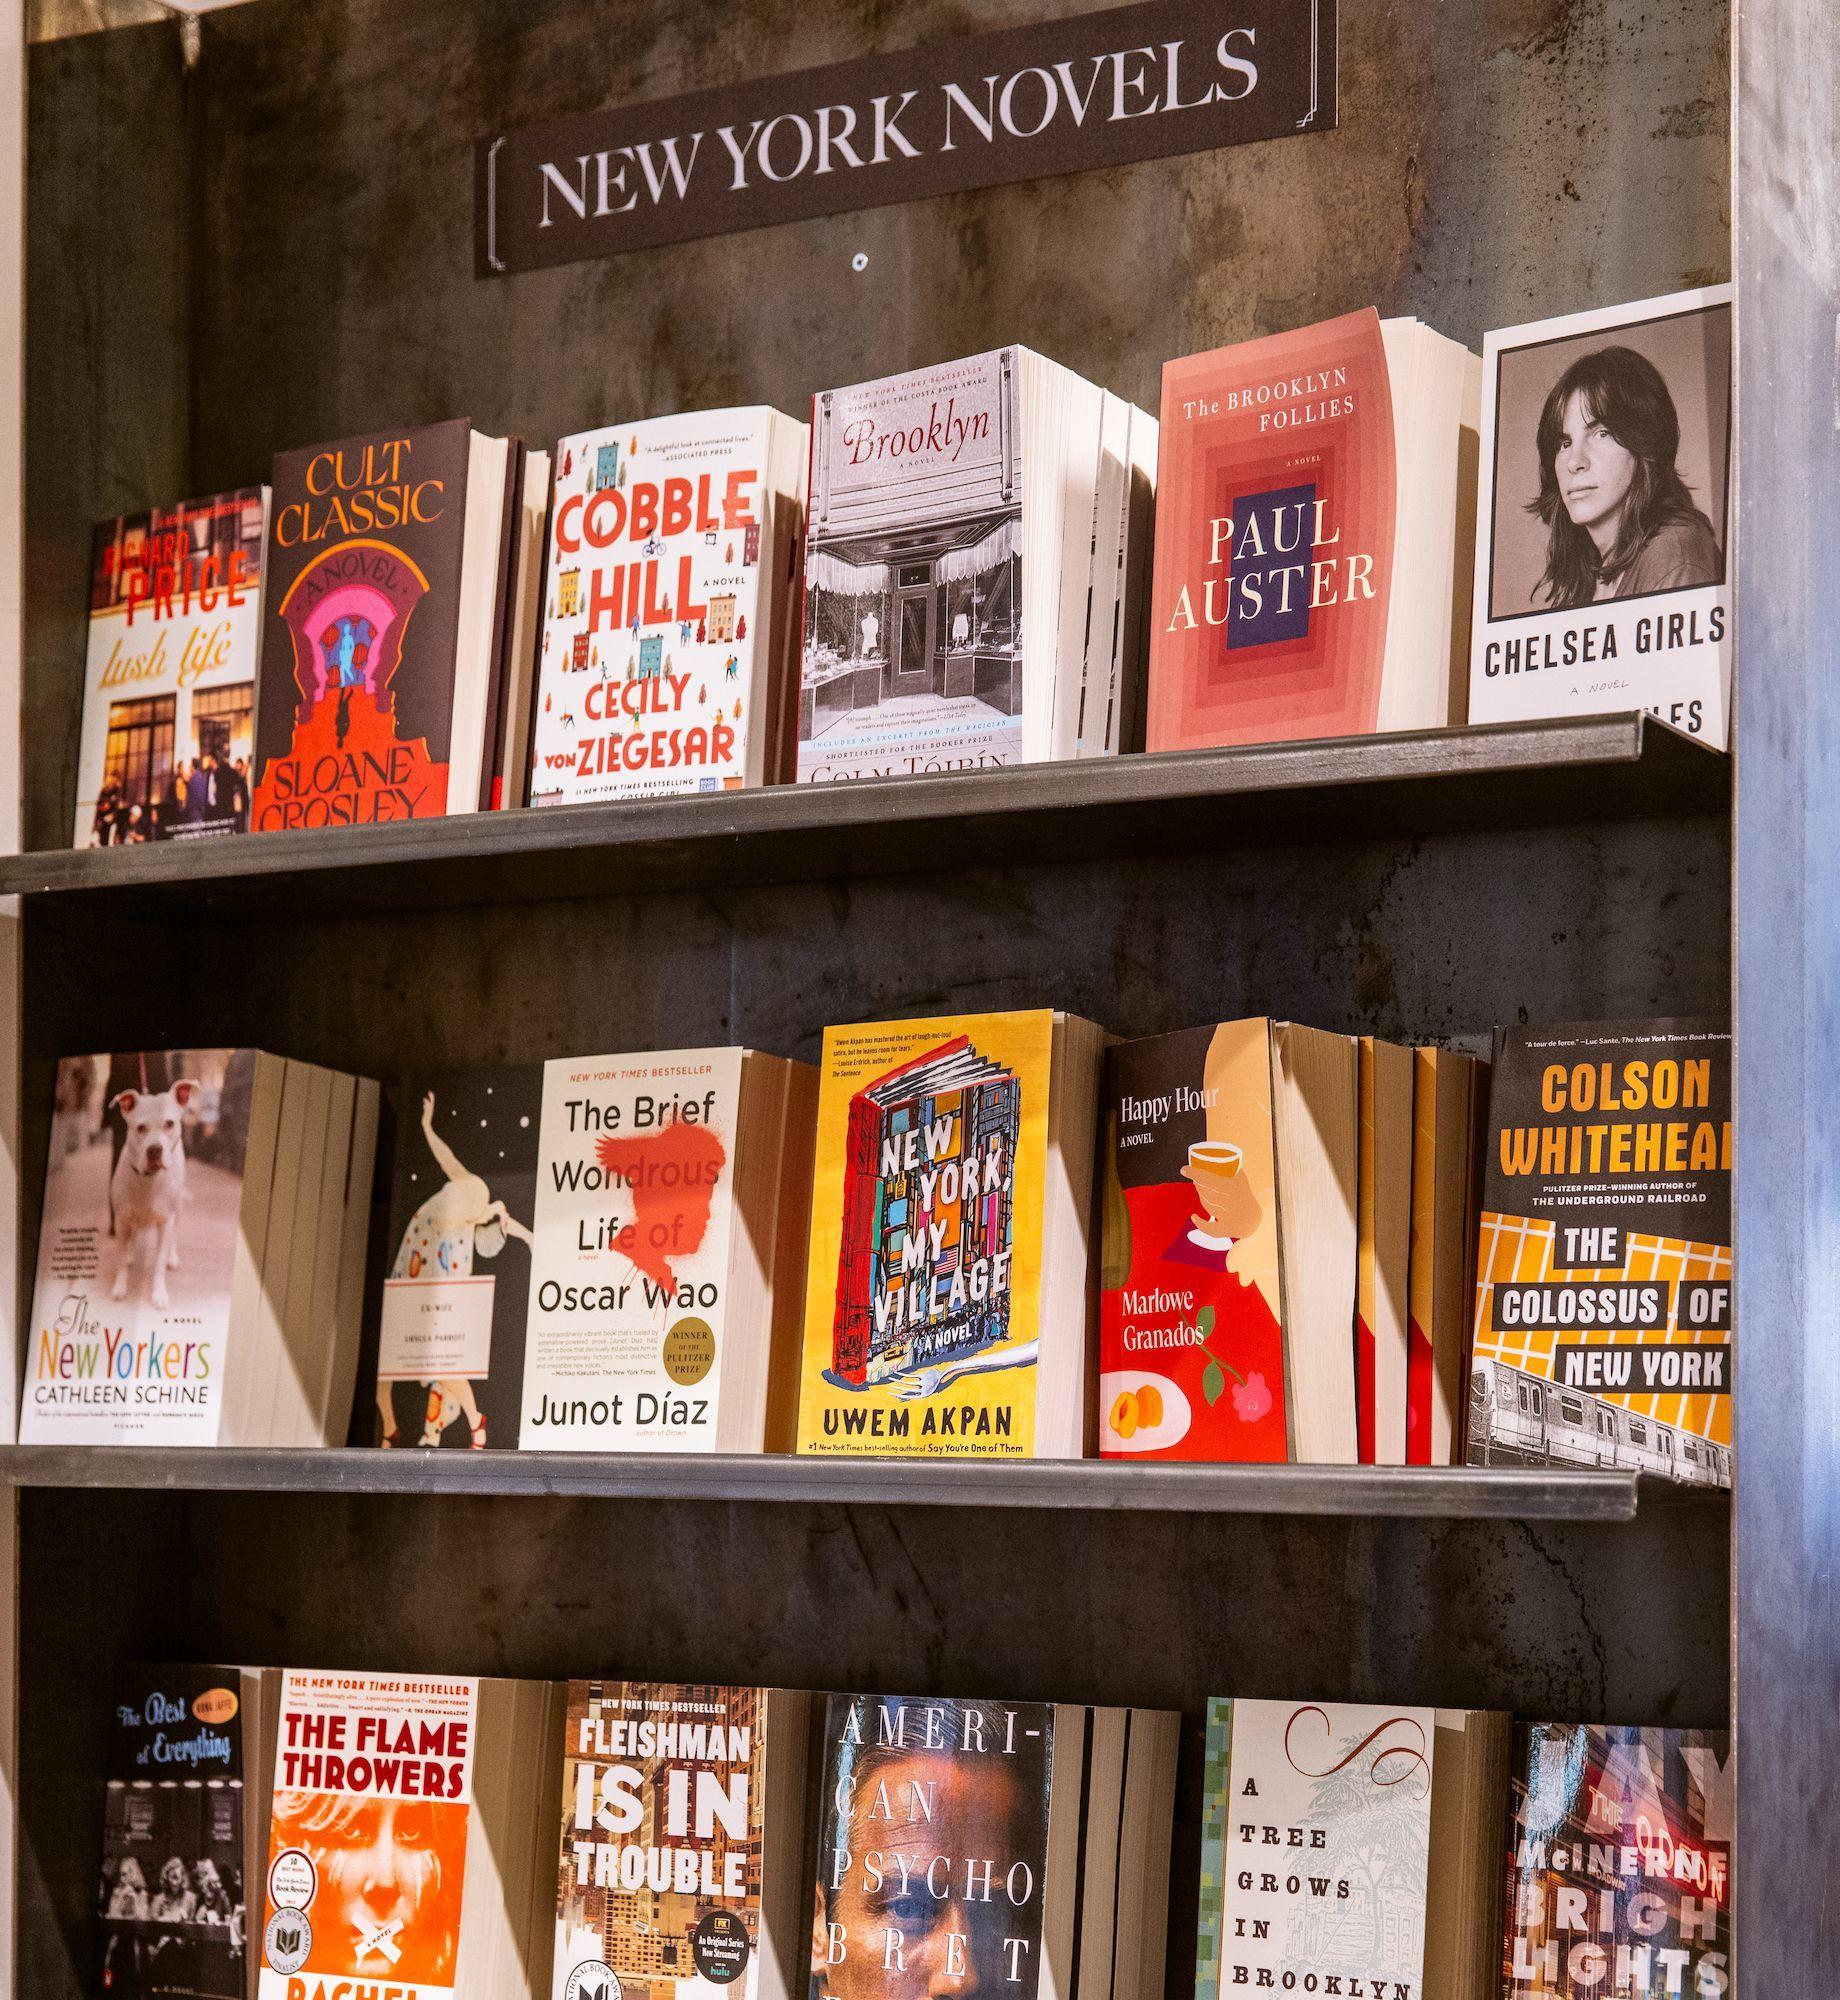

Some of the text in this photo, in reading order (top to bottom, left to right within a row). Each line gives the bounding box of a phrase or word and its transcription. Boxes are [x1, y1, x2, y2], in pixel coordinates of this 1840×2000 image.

[538, 27, 1261, 229] NEW YORK NOVELS
[1183, 367, 1348, 419] The BROOKLYN
[844, 398, 989, 465] Brooklyn
[1259, 395, 1355, 433] FOLLIES
[305, 438, 411, 496] CULT
[1294, 455, 1321, 466] NOVEL
[276, 480, 444, 548] CLASSIC
[555, 469, 758, 553] COBBLE
[1207, 498, 1339, 565] PAUL
[104, 530, 189, 577] RICHARD
[306, 551, 398, 596] A NOVEL
[127, 551, 248, 626] PRICE
[588, 555, 707, 633] HILL
[703, 576, 746, 587] A NOVEL
[1166, 554, 1376, 632] AUSTER
[100, 621, 231, 689] lush life
[1485, 606, 1725, 677] CHELSEA GIRLS
[584, 673, 691, 722] CECILY
[1569, 679, 1629, 695] A NOVEL
[576, 725, 734, 777] ZIEGESAR
[274, 746, 415, 800] SLOANE
[259, 786, 427, 831] CROSLEY
[570, 1065, 712, 1082] NEW YORK TIMES BESTSELLER
[1542, 1059, 1711, 1113] COLSON
[565, 1091, 715, 1132] The Brief
[1121, 1085, 1219, 1126] Happy Hour
[881, 1115, 954, 1177] NEW
[1120, 1133, 1154, 1148] A NOVEL
[552, 1155, 720, 1192] Wondrous
[920, 1147, 1011, 1212] YORK,
[1558, 1195, 1644, 1205] UNDERGROUND
[1648, 1194, 1707, 1203] RAILROAD
[579, 1214, 684, 1251] Life of
[902, 1218, 947, 1273] MY
[1564, 1227, 1617, 1262] THE
[538, 1277, 718, 1312] Oscar Wao
[874, 1250, 1012, 1333] VILLAGE
[1122, 1287, 1193, 1317] Marlowe
[1502, 1288, 1728, 1324] COLOSSUS OF
[53, 1294, 99, 1336] The
[672, 1331, 707, 1340] WINNER
[37, 1328, 210, 1380] New Yorkers
[924, 1322, 972, 1352] A NOVEL
[1124, 1324, 1204, 1351] Granados
[667, 1354, 710, 1362] PULITZER
[675, 1365, 701, 1374] PRIZE
[1565, 1351, 1723, 1387] NEW YORK
[34, 1386, 208, 1404] CATHLEEN SCHINE
[532, 1391, 708, 1426] Junot Díaz
[823, 1406, 1012, 1437] UWEM AKPAN
[865, 1444, 898, 1453] best-selling
[928, 1444, 943, 1455] Say
[971, 1444, 986, 1452] One
[988, 1443, 997, 1452] of
[1000, 1444, 1023, 1453] Them
[290, 1677, 470, 1696] THE NEW YORK TIMES BESTSELLER
[601, 1699, 726, 1714] NEW YORK TIMES BESTSELLER
[117, 1705, 141, 1726] The
[145, 1691, 187, 1725] Best
[838, 1702, 1040, 1754] AMERI-
[153, 1727, 231, 1768] Everything
[286, 1713, 468, 1758] THE FLAME
[579, 1718, 751, 1762] FLEISHMAN
[283, 1752, 464, 1798] THROWERS
[1242, 1778, 1259, 1796] A
[574, 1763, 748, 1841] IS IN
[834, 1774, 937, 1823] CAN
[1240, 1824, 1326, 1849] TREE
[573, 1841, 748, 1897] TROUBLE
[830, 1848, 1033, 1906] PSYCHO
[1238, 1871, 1350, 1899] GROWS
[699, 1935, 744, 1948] An Original Series
[1235, 1918, 1270, 1939] IN
[702, 1947, 740, 1961] Now Streaming
[711, 1966, 730, 1976] hulu
[825, 1921, 1029, 1982] BRET
[1512, 1937, 1728, 1997] LIGHTS
[1232, 1965, 1411, 2000] BROOKLYN
